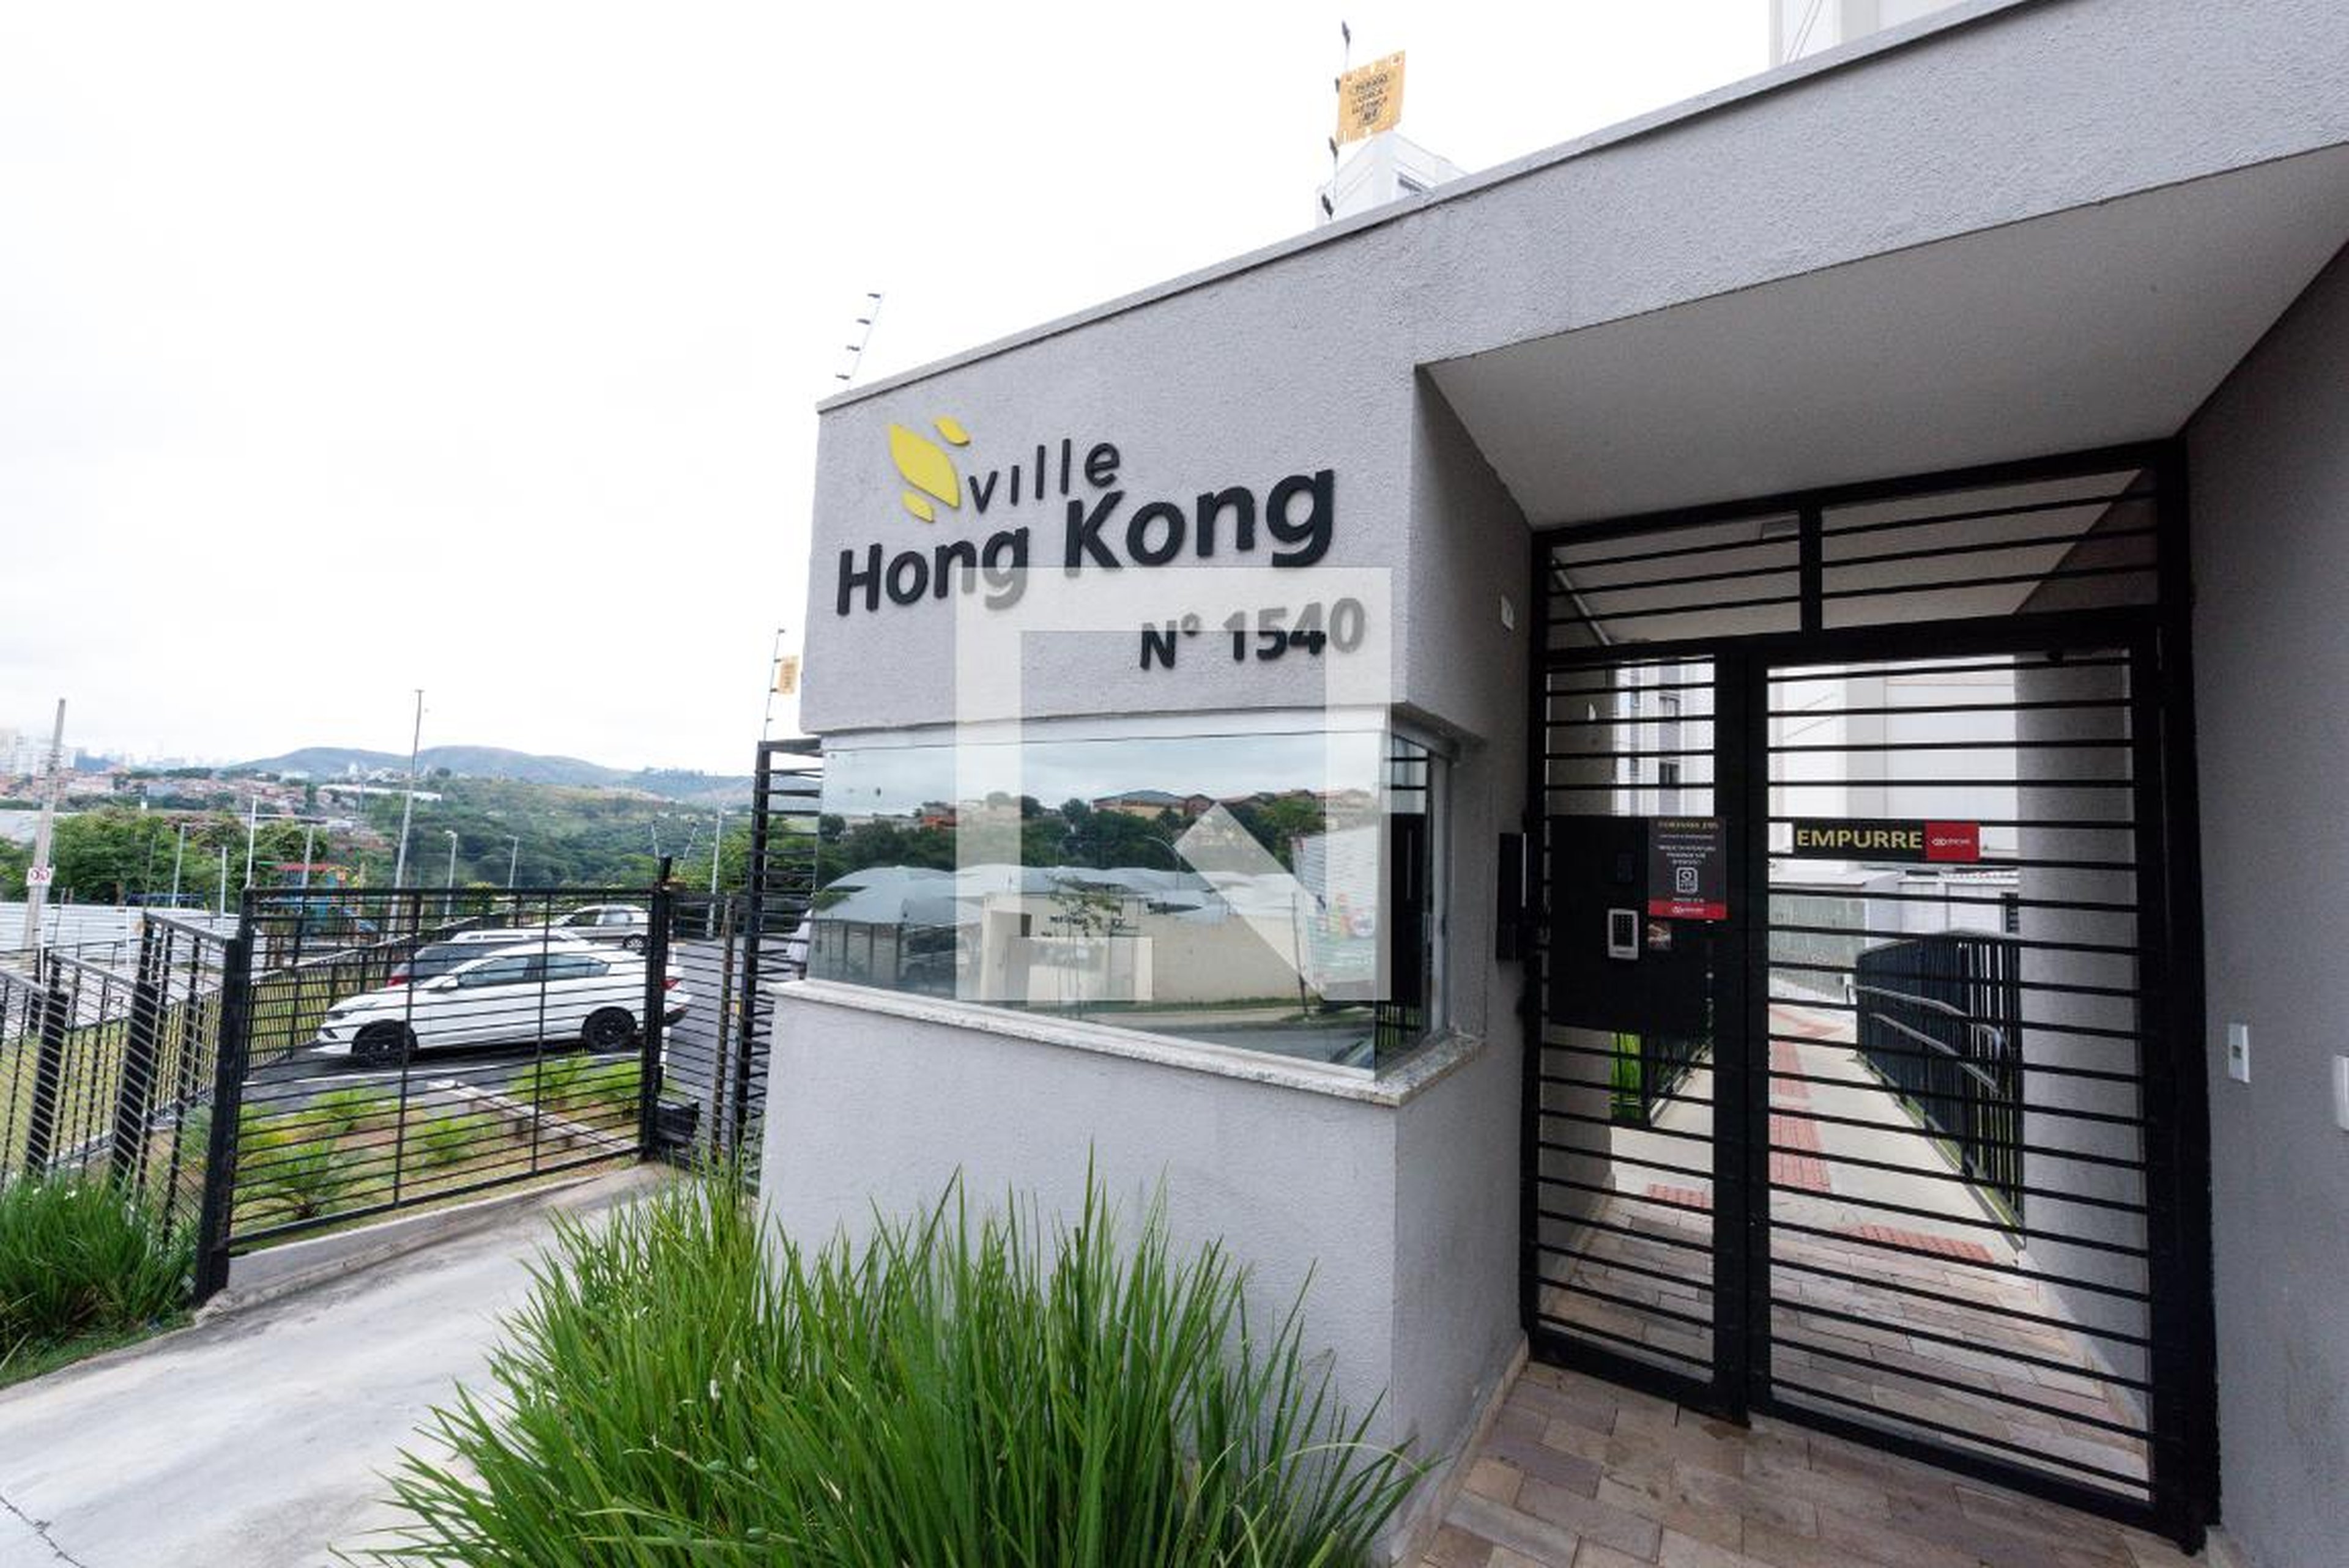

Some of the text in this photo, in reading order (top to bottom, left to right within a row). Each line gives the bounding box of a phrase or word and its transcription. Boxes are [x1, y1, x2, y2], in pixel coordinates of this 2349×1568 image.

[969, 438, 1120, 513] ville
[837, 468, 1336, 615] Hong Kong
[1225, 597, 1365, 660] 1540
[1797, 829, 1923, 849] EMPURRE
